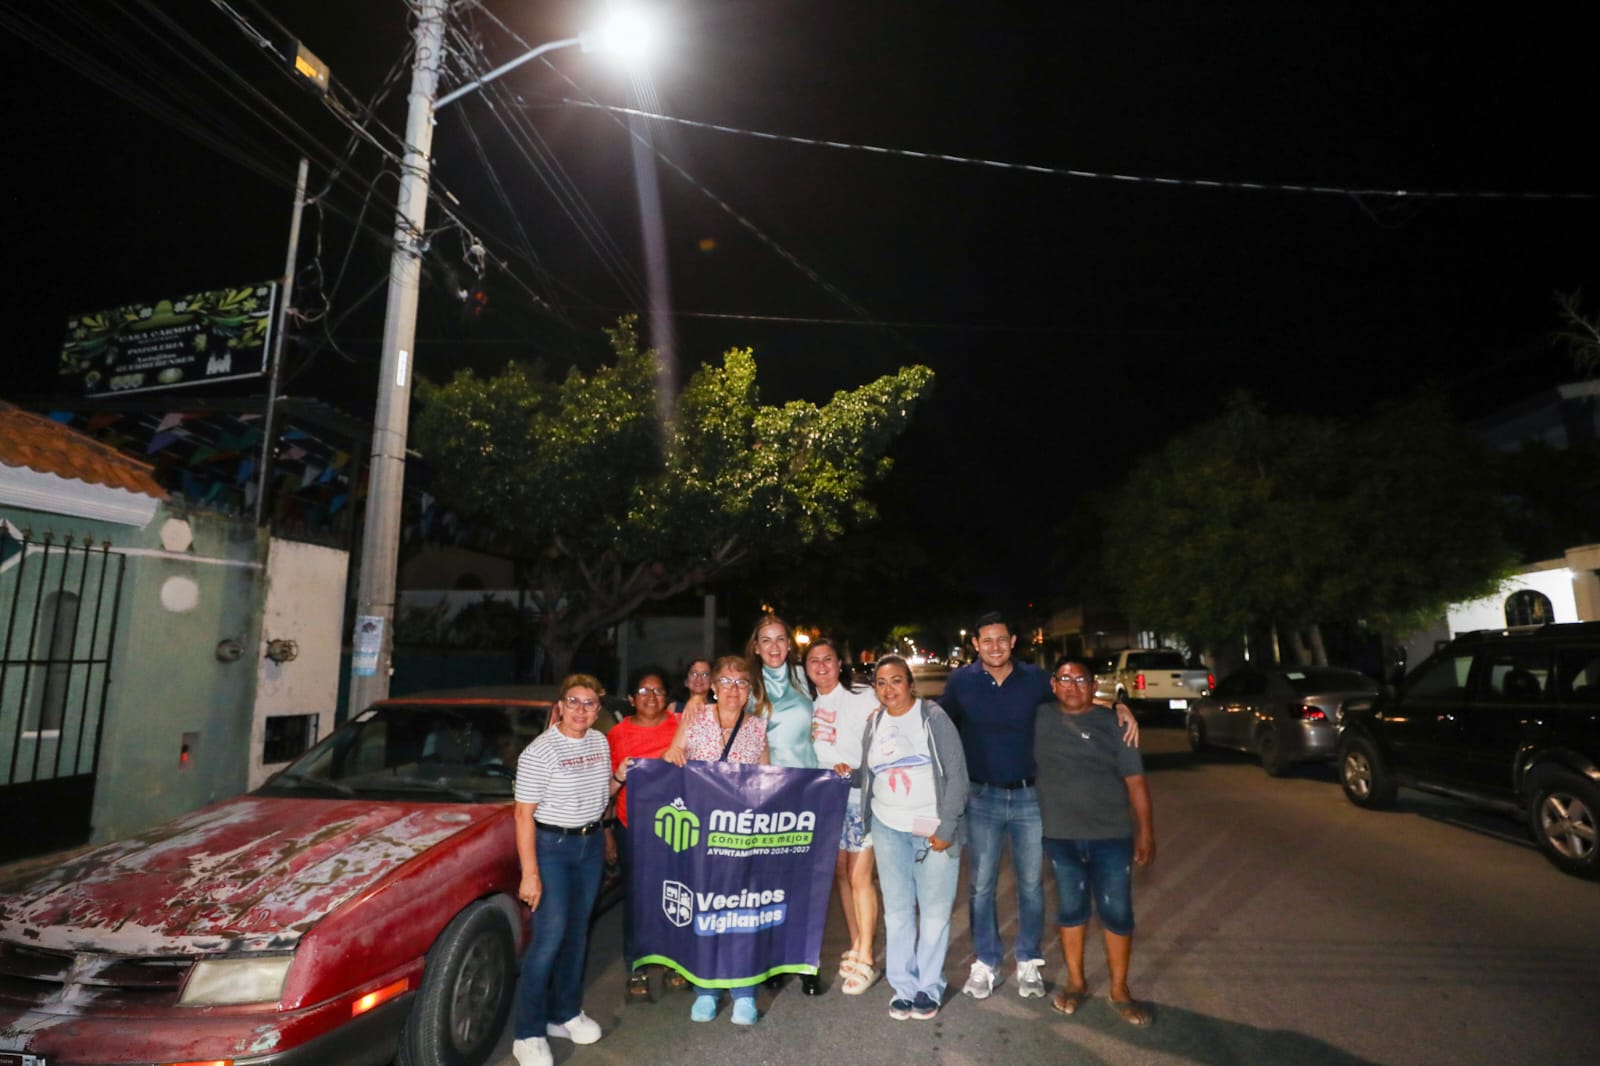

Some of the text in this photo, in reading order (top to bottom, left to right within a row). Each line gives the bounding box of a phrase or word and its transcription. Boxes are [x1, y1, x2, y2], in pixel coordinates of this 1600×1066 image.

[709, 809, 816, 834] MÉRIDA
[711, 835, 758, 846] CONTIGO
[777, 834, 809, 843] MEJOR
[697, 888, 785, 911] Vecinos
[697, 910, 783, 933] Vigilantes
